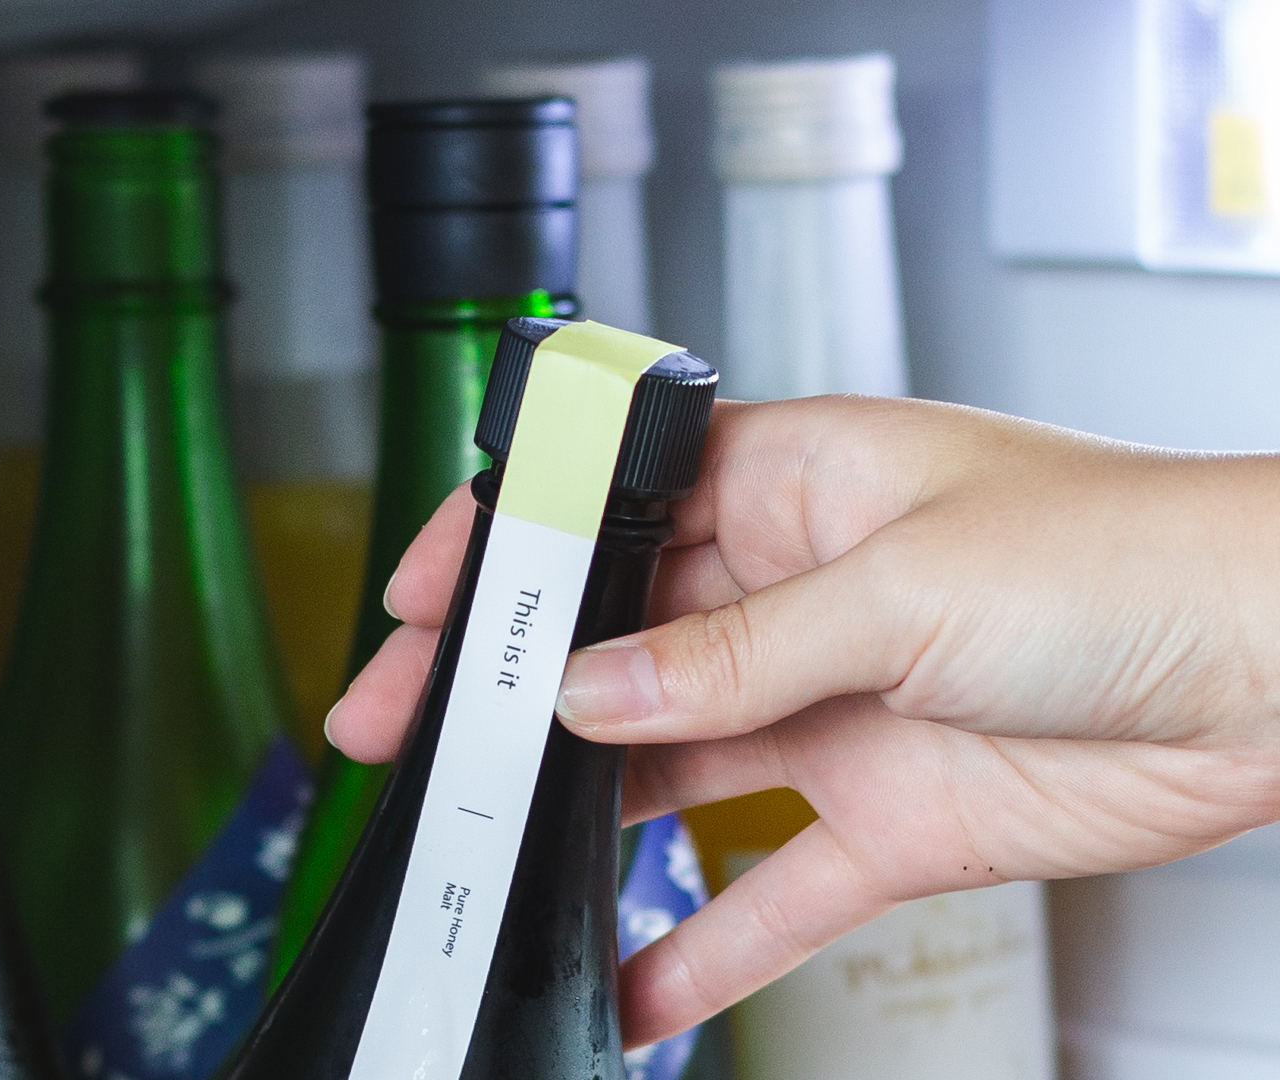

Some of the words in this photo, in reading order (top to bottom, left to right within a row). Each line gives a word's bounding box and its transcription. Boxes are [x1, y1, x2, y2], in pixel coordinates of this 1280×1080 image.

[510, 589, 541, 638] This
[504, 645, 526, 664] is
[497, 671, 519, 690] it
[440, 882, 457, 910] Malt
[454, 886, 471, 915] Pure
[442, 917, 463, 958] Honey
